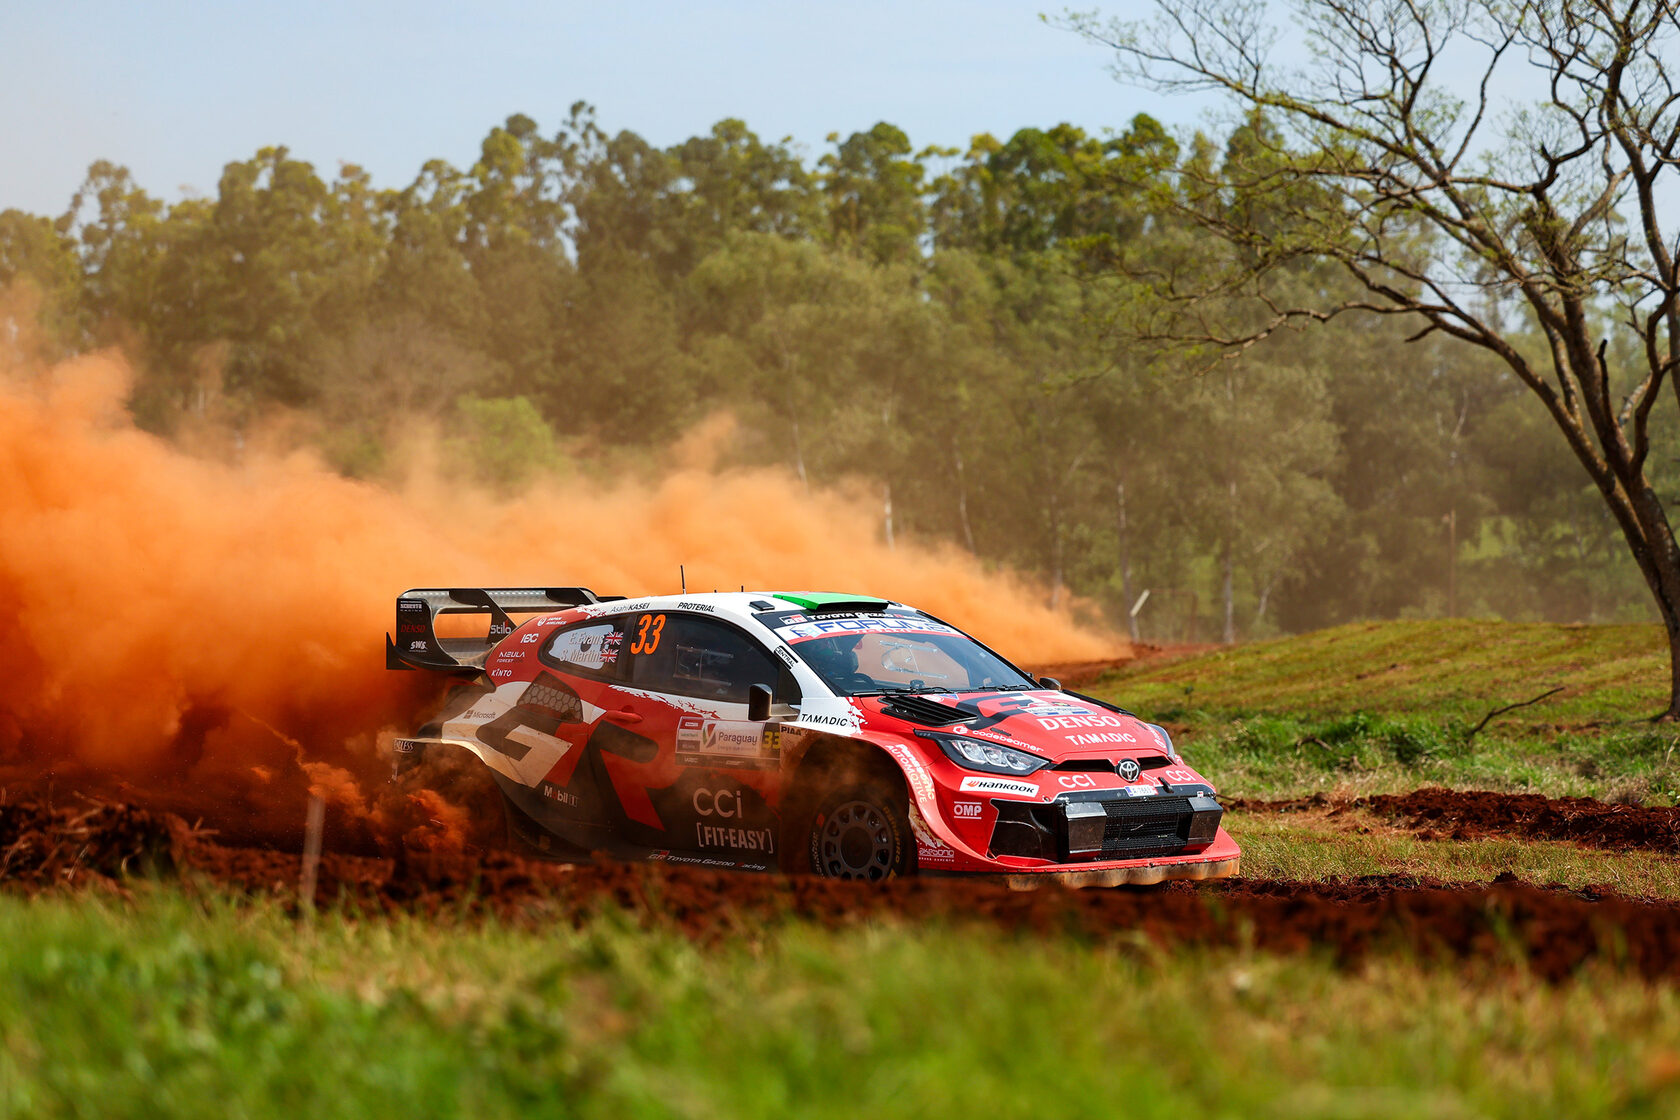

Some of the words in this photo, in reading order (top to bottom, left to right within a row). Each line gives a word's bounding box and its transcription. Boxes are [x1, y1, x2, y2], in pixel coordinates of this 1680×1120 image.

[677, 601, 715, 613] PROTERIAL
[807, 613, 855, 621] TOYOTA
[401, 624, 426, 633] DENSO
[490, 620, 512, 635] Stilo
[630, 614, 667, 655] 33
[775, 646, 795, 668] CENTRAL
[472, 711, 497, 719] Microsoft
[801, 713, 848, 727] TAMADIC
[780, 725, 802, 736] PIAA
[1037, 715, 1121, 731] DENSO
[718, 731, 758, 746] Paraguay
[763, 731, 780, 751] 33
[972, 729, 1044, 753] codebeamer
[1065, 733, 1137, 746] TAMADIC
[884, 744, 928, 804] AUTOMOTIVE
[895, 743, 935, 801] Panasonic
[1165, 770, 1197, 782] CCI
[1057, 774, 1097, 789] CCI
[543, 785, 569, 804] Mobil
[953, 804, 982, 817] OMP
[667, 855, 701, 864] TOYOTA
